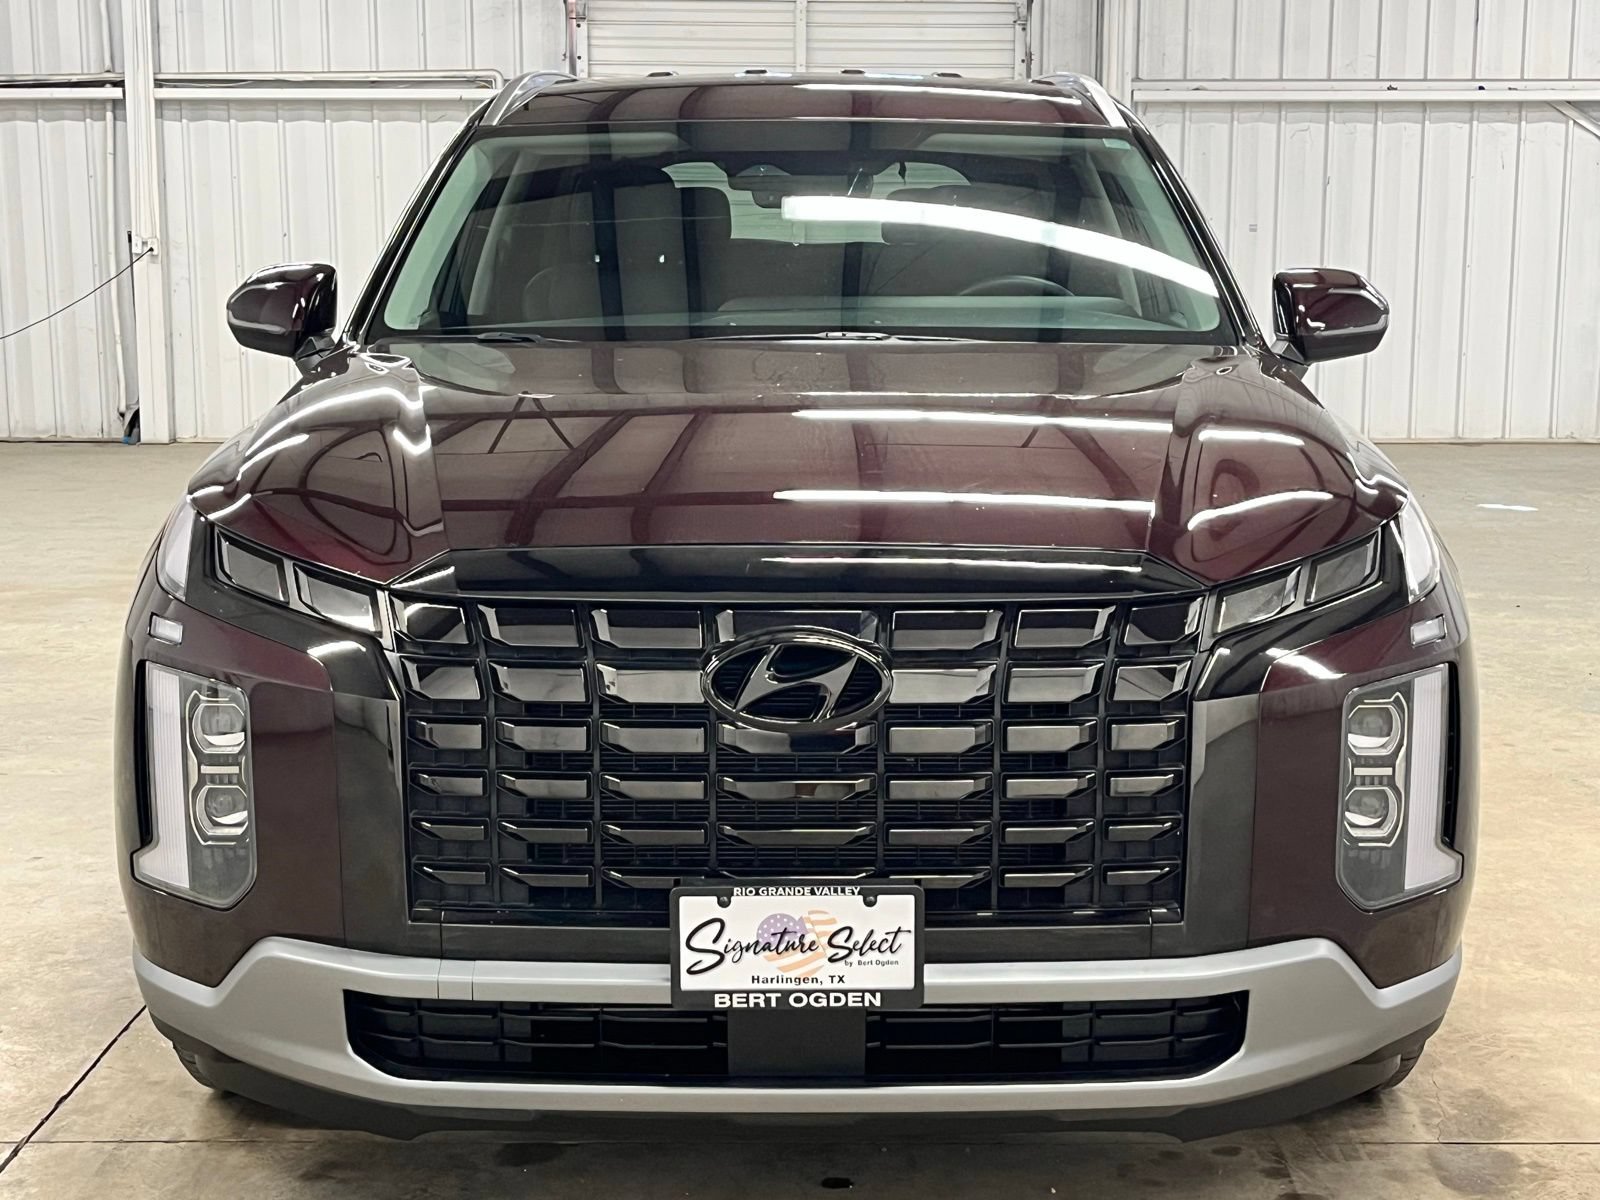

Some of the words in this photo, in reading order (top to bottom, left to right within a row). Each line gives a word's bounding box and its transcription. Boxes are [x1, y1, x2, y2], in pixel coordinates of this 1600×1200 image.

[734, 888, 755, 896] RIO
[759, 888, 811, 896] GRANDE
[814, 887, 860, 896] VALLEY
[686, 918, 819, 975] Signature
[827, 926, 912, 963] Select
[752, 974, 823, 986] Harlingen,
[828, 975, 845, 984] TX
[714, 994, 781, 1008] BERT
[788, 992, 881, 1007] OGDEN
